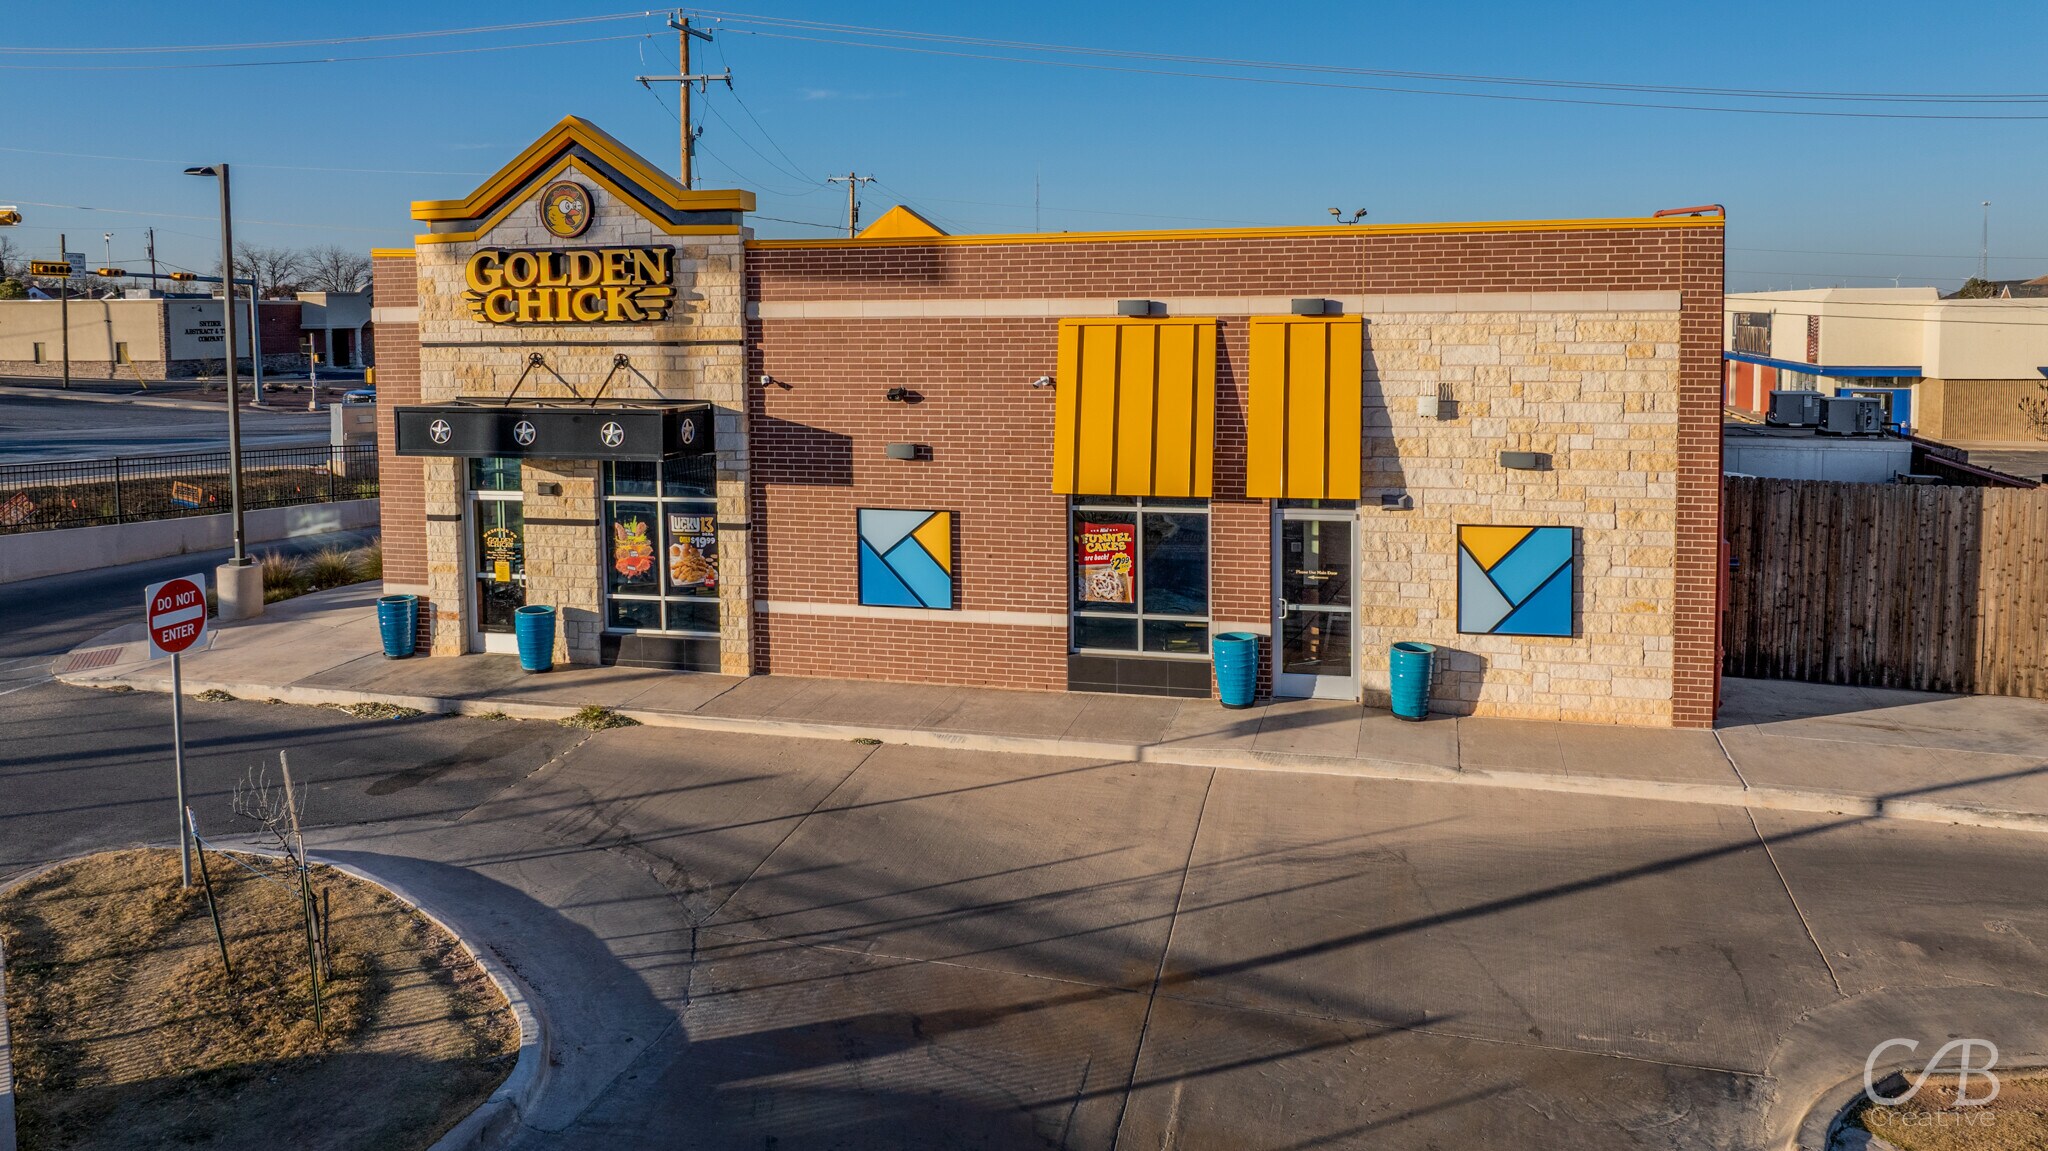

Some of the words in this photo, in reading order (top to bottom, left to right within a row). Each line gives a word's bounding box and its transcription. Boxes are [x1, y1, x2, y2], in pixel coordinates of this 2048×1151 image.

[465, 248, 669, 293] GOLDEN
[485, 287, 646, 322] CHICK
[670, 515, 700, 532] LUCKY
[700, 516, 715, 533] 13
[1081, 533, 1132, 544] FUNNEL
[1085, 541, 1127, 553] CAKES
[157, 596, 172, 612] DO
[176, 590, 196, 607] NOT
[162, 623, 195, 643] ENTER
